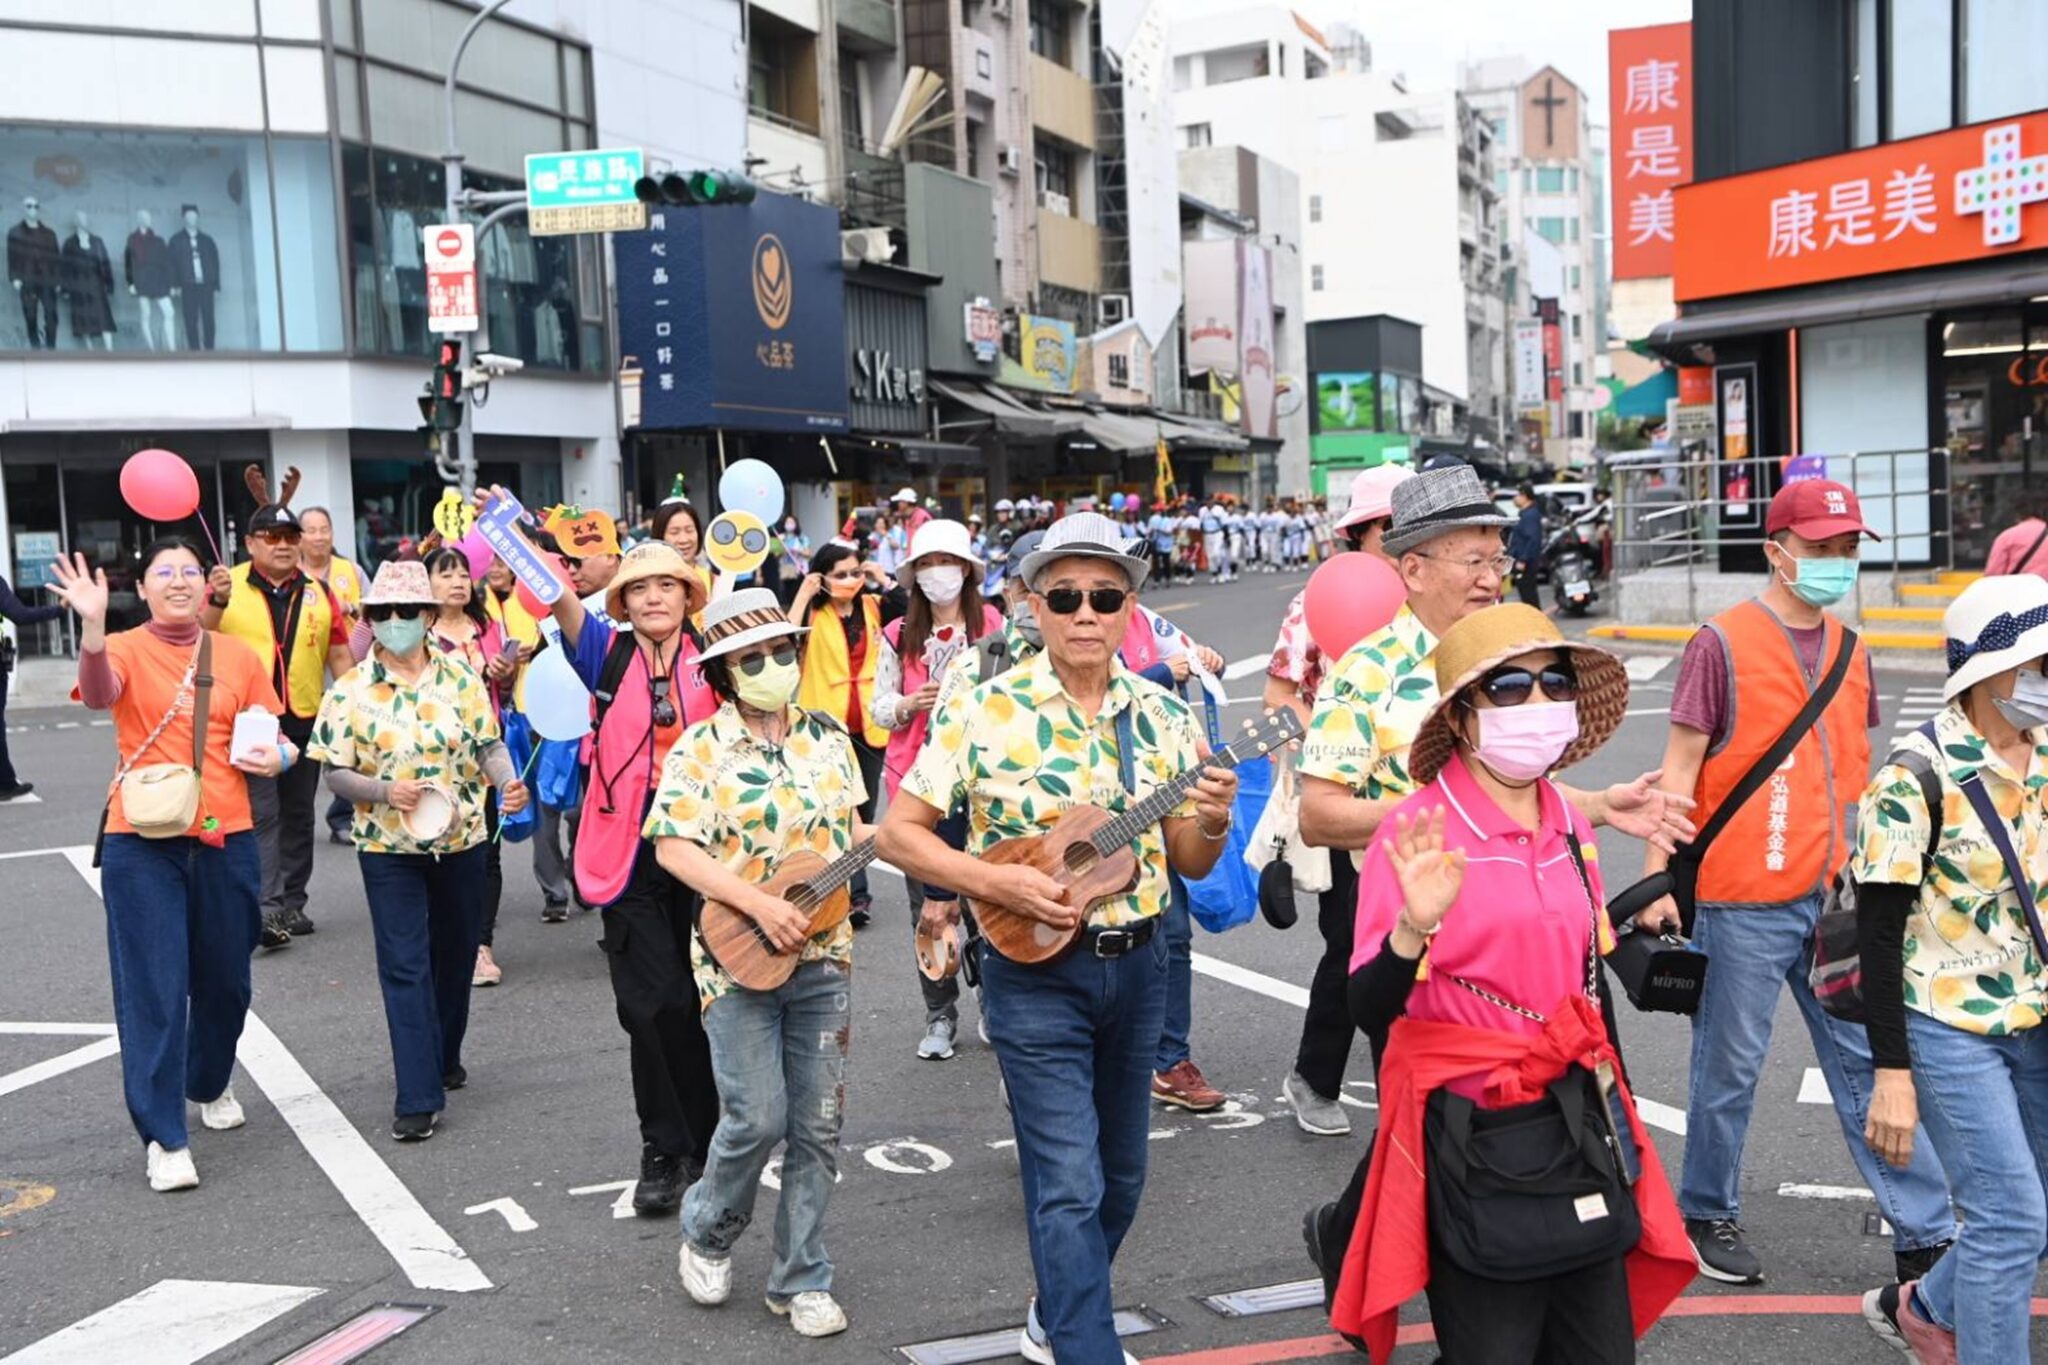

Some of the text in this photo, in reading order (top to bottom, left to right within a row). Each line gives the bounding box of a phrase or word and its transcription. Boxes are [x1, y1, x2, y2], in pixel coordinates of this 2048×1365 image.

[1623, 59, 1681, 246] 康是美
[1768, 164, 1938, 260] 康是美
[650, 214, 674, 390] 用心品一口好茶
[1765, 775, 1789, 871] 弘道基金會
